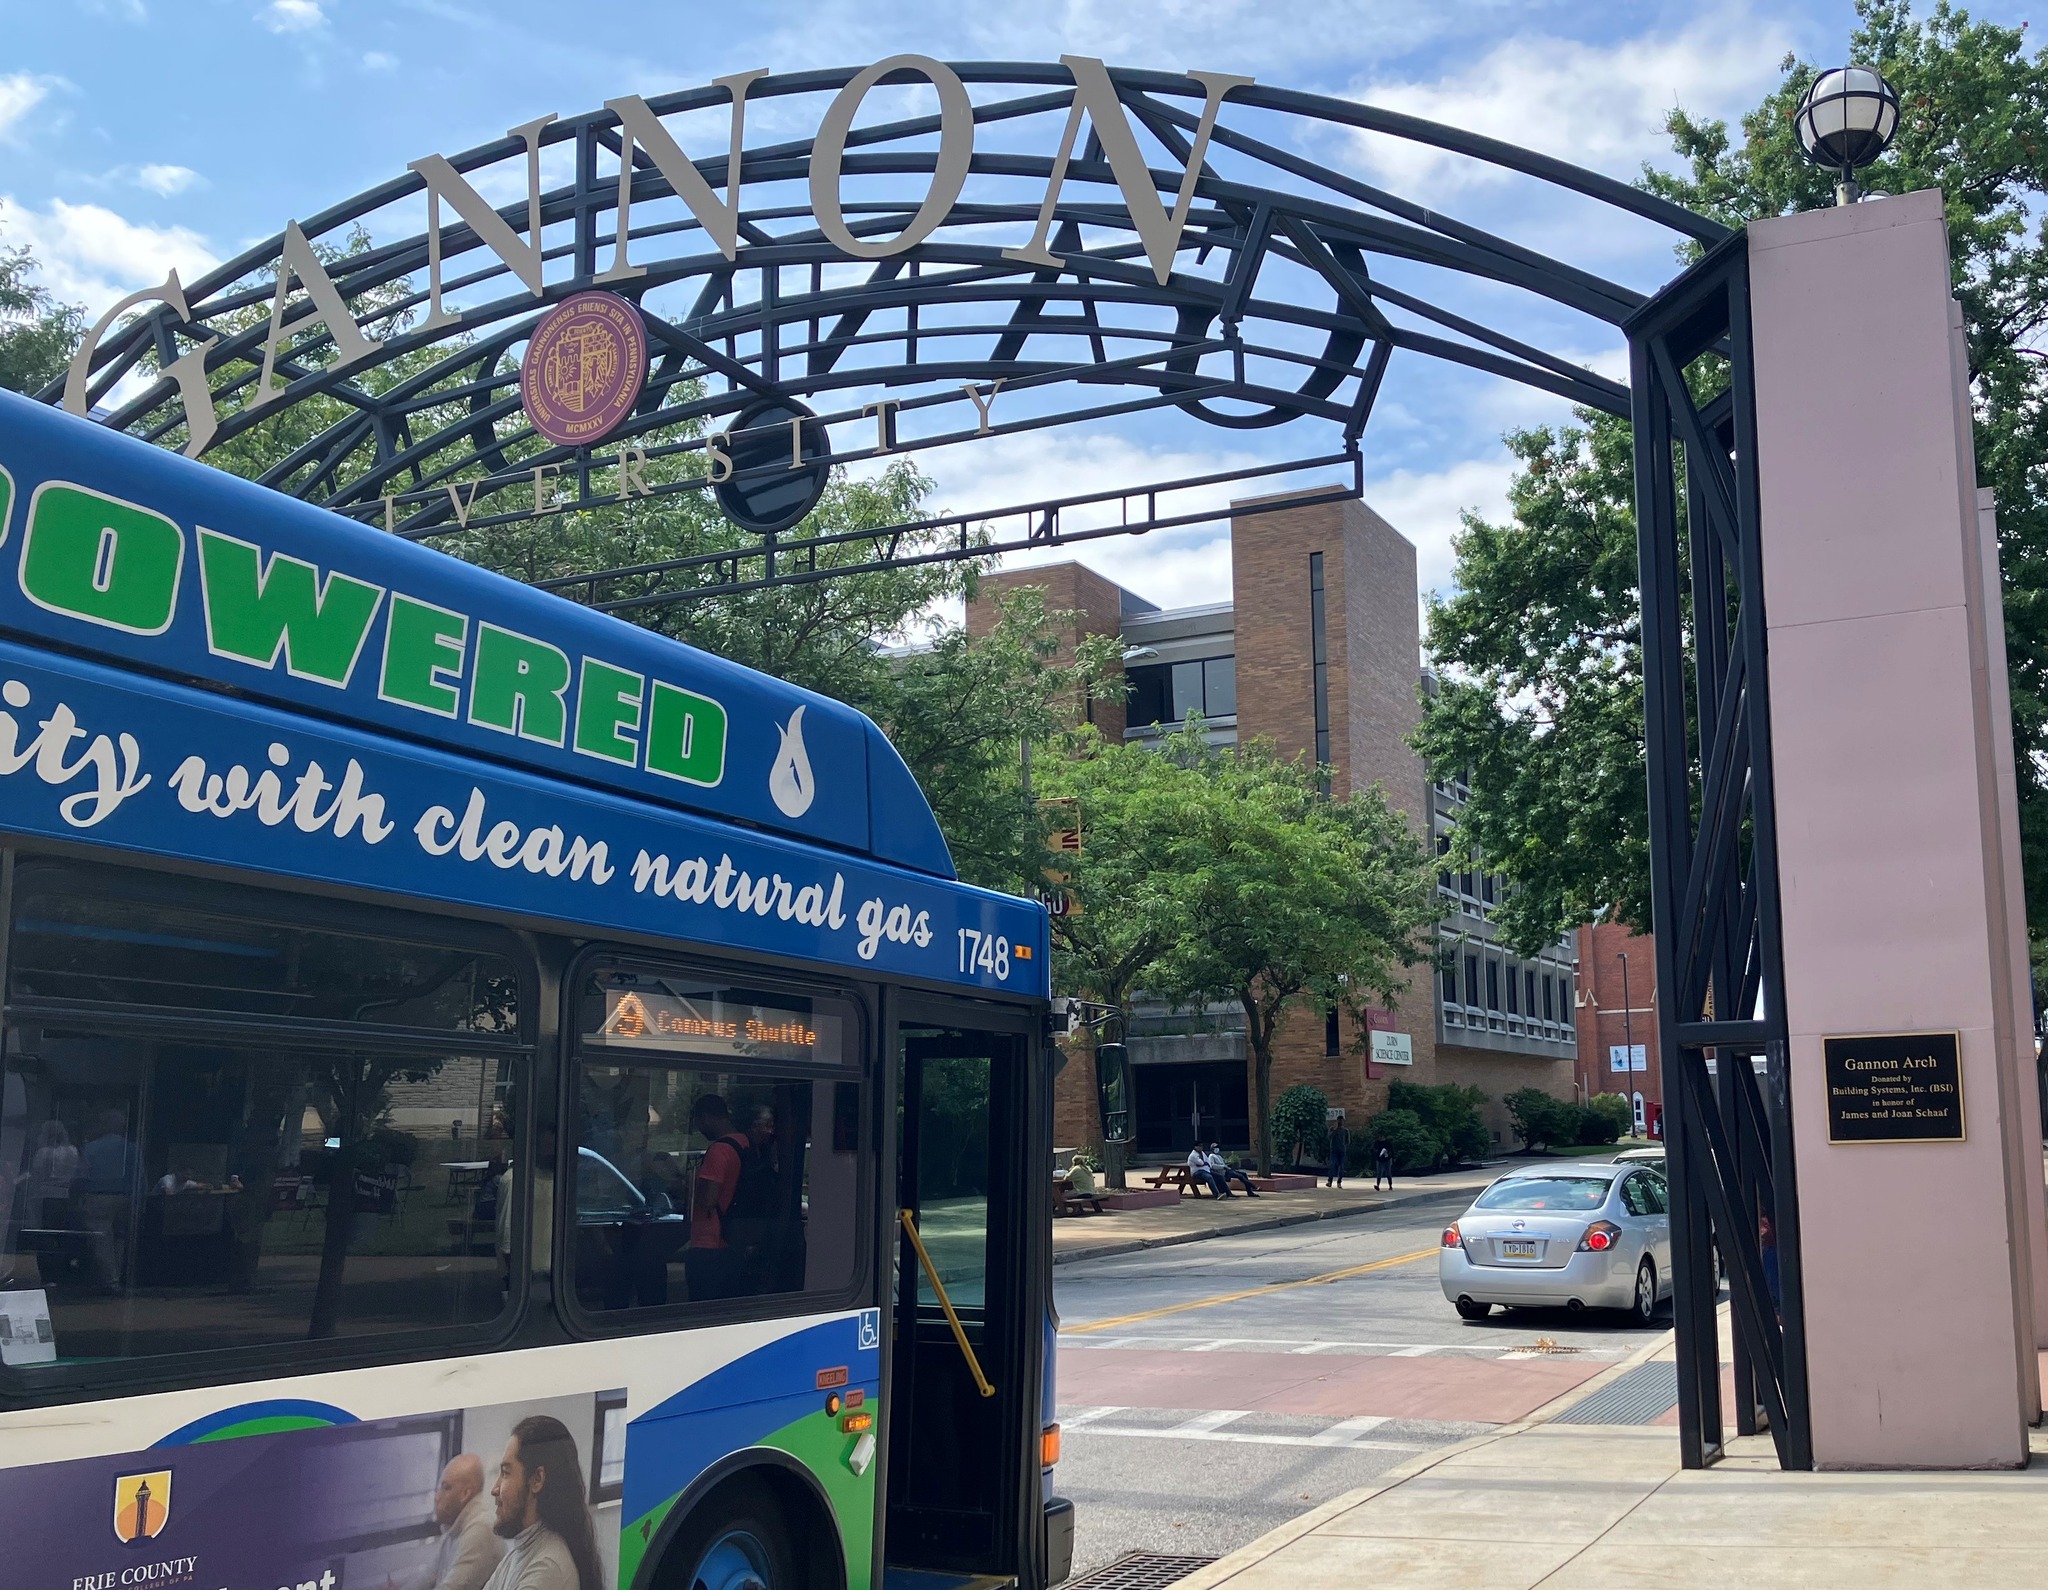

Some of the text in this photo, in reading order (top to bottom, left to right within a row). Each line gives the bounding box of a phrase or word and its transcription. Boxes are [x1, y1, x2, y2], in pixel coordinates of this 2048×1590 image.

[62, 53, 1255, 458] GANNON
[577, 302, 609, 314] ERIENSI
[608, 308, 625, 324] SITA
[531, 307, 575, 365] GANNONENSIS
[622, 323, 633, 336] IN
[613, 336, 638, 409] PENNSYLVANIA
[528, 368, 551, 424] UNIVERSITAS
[565, 415, 604, 434] MCMXXV
[328, 377, 1009, 533] IVERSITY
[0, 462, 729, 788] OWERED
[168, 742, 395, 845] with
[413, 786, 615, 885] clean
[630, 848, 847, 931] natural
[856, 896, 934, 960] gas
[957, 926, 1010, 981] 1748
[658, 1010, 737, 1038] Campus
[745, 1019, 817, 1046] Shuttle
[1386, 1035, 1398, 1046] ZURN
[1375, 1048, 1410, 1061] SCIENCE CENTER
[1845, 1055, 1937, 1070] Gannon Arch
[1871, 1075, 1912, 1083] Donated by
[1832, 1083, 1954, 1096] Building Systems, Inc. (BSI)
[1872, 1098, 1915, 1107] in honor of
[1841, 1108, 1949, 1119] James and Joan Schaaf
[73, 1571, 116, 1590] ERIE
[121, 1556, 198, 1585] COUNTY
